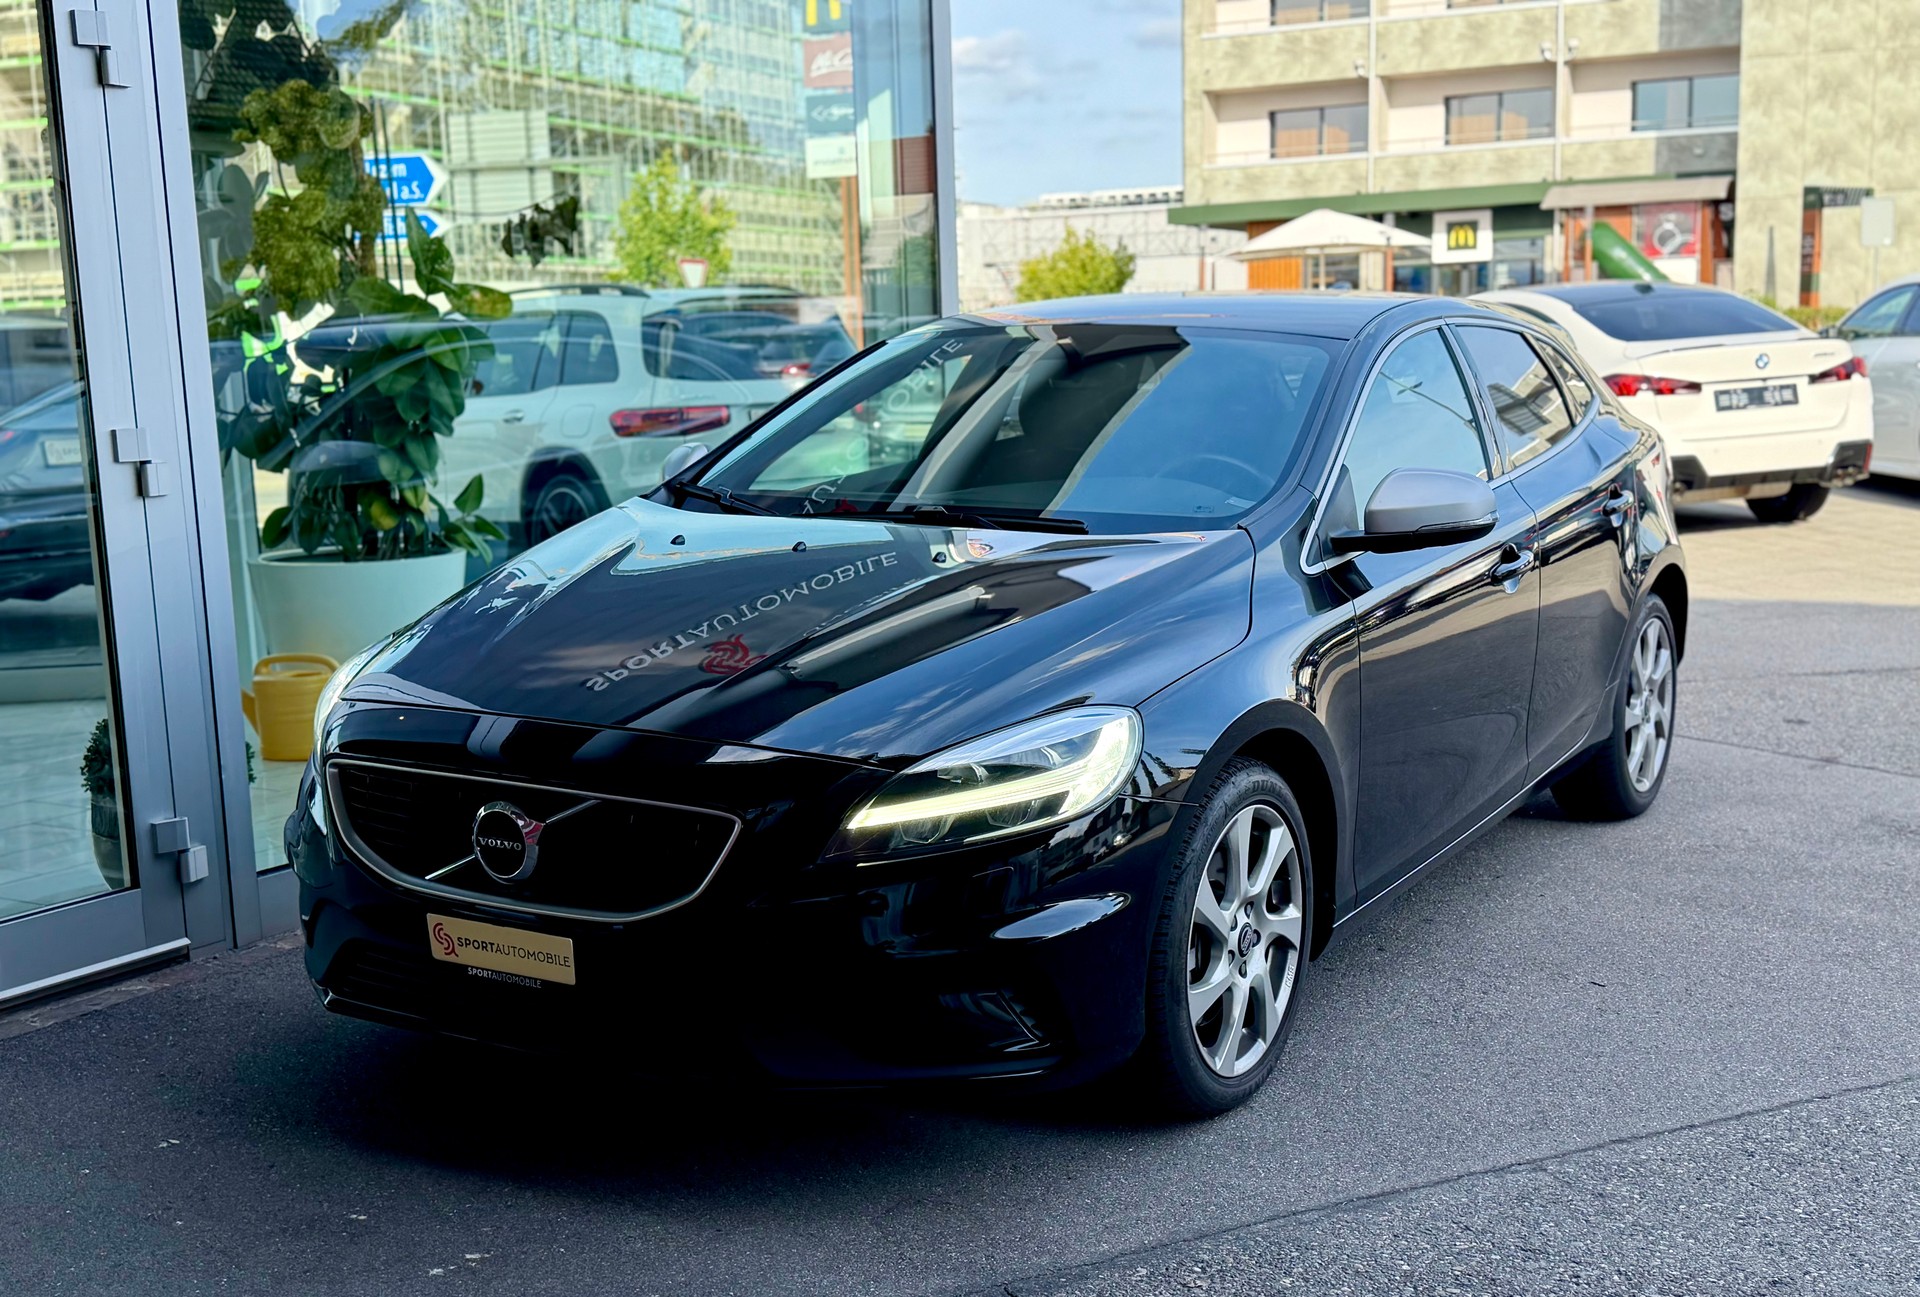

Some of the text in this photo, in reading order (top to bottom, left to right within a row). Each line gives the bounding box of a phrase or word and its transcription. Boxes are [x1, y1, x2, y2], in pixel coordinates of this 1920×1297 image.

[478, 836, 522, 851] VOLVO
[457, 937, 571, 967] SPORTAUTOMOBILE
[468, 967, 542, 988] SPORTAUTOMOBILE
